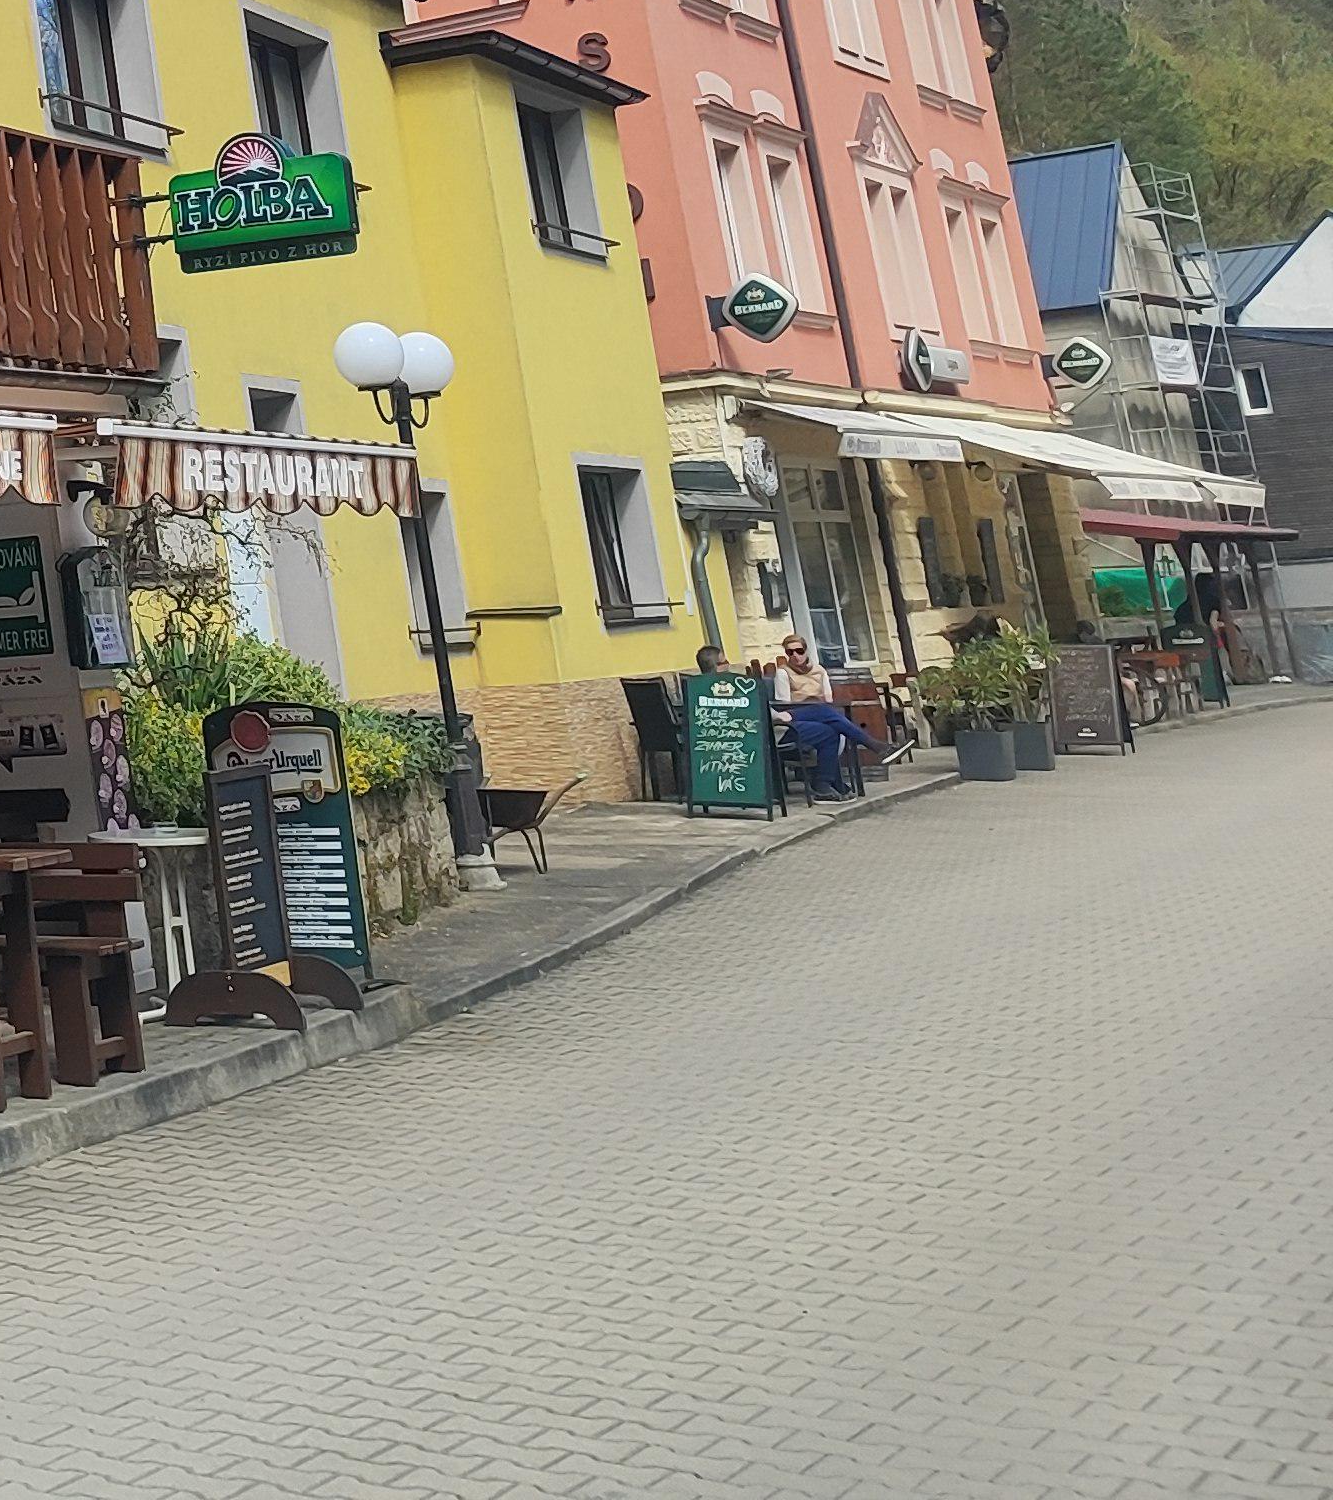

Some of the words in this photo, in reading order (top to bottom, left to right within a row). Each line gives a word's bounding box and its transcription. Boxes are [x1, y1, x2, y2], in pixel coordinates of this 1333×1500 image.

[173, 174, 334, 236] HOLBA
[193, 254, 233, 271] RYZÍ
[240, 248, 281, 265] PIVO
[287, 246, 298, 259] Z
[305, 240, 344, 256] HOR
[182, 447, 365, 500] RESTAURANT
[23, 629, 50, 649] FREI
